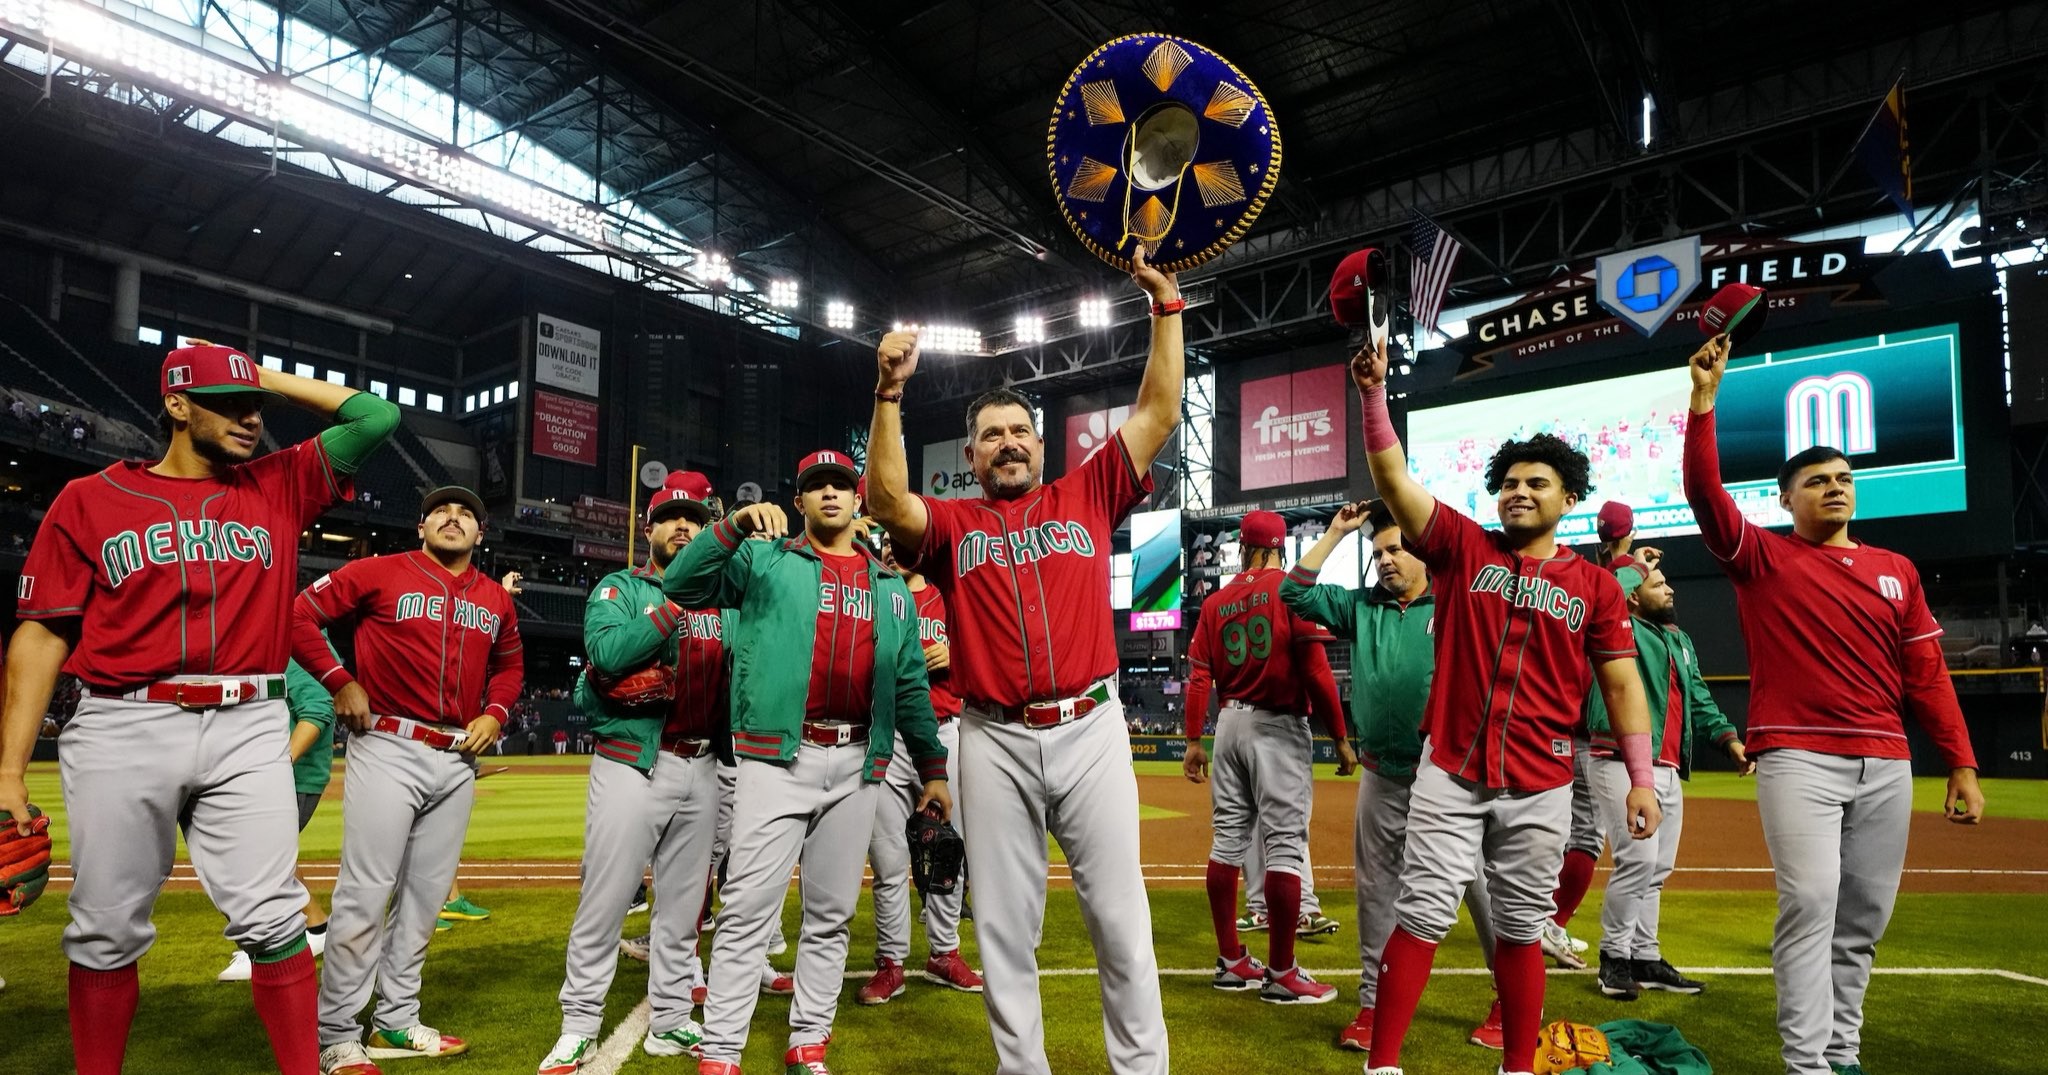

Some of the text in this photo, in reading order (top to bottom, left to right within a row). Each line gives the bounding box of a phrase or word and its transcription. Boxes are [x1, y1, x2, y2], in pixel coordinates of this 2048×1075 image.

[1479, 252, 1847, 343] CHASE FIELD
[1518, 297, 1796, 356] HOME OF THE DIACKS
[539, 342, 598, 370] DOWNLOAD IT
[546, 424, 587, 440] LOCATION
[1252, 406, 1331, 445] fry's
[552, 442, 580, 455] 69050
[1255, 444, 1330, 462] FRESH FOR EVERYONE
[1199, 508, 1218, 518] WEST
[1220, 503, 1260, 515] CHAMPIONS
[1274, 493, 1344, 509] WORLD CHAMPIONS
[102, 518, 273, 589] MEXICO
[958, 520, 1096, 578] MEXICO
[1204, 565, 1242, 577] WILD CARD
[819, 582, 872, 622] EXI
[1219, 592, 1270, 618] WALER
[1469, 564, 1586, 633] MEXICO
[395, 592, 501, 644] MEXICO
[677, 609, 722, 641] EXIC
[1136, 615, 1175, 630] $13,770
[1222, 614, 1272, 667] 99
[1131, 744, 1157, 754] 2023
[2010, 751, 2032, 761] 413
